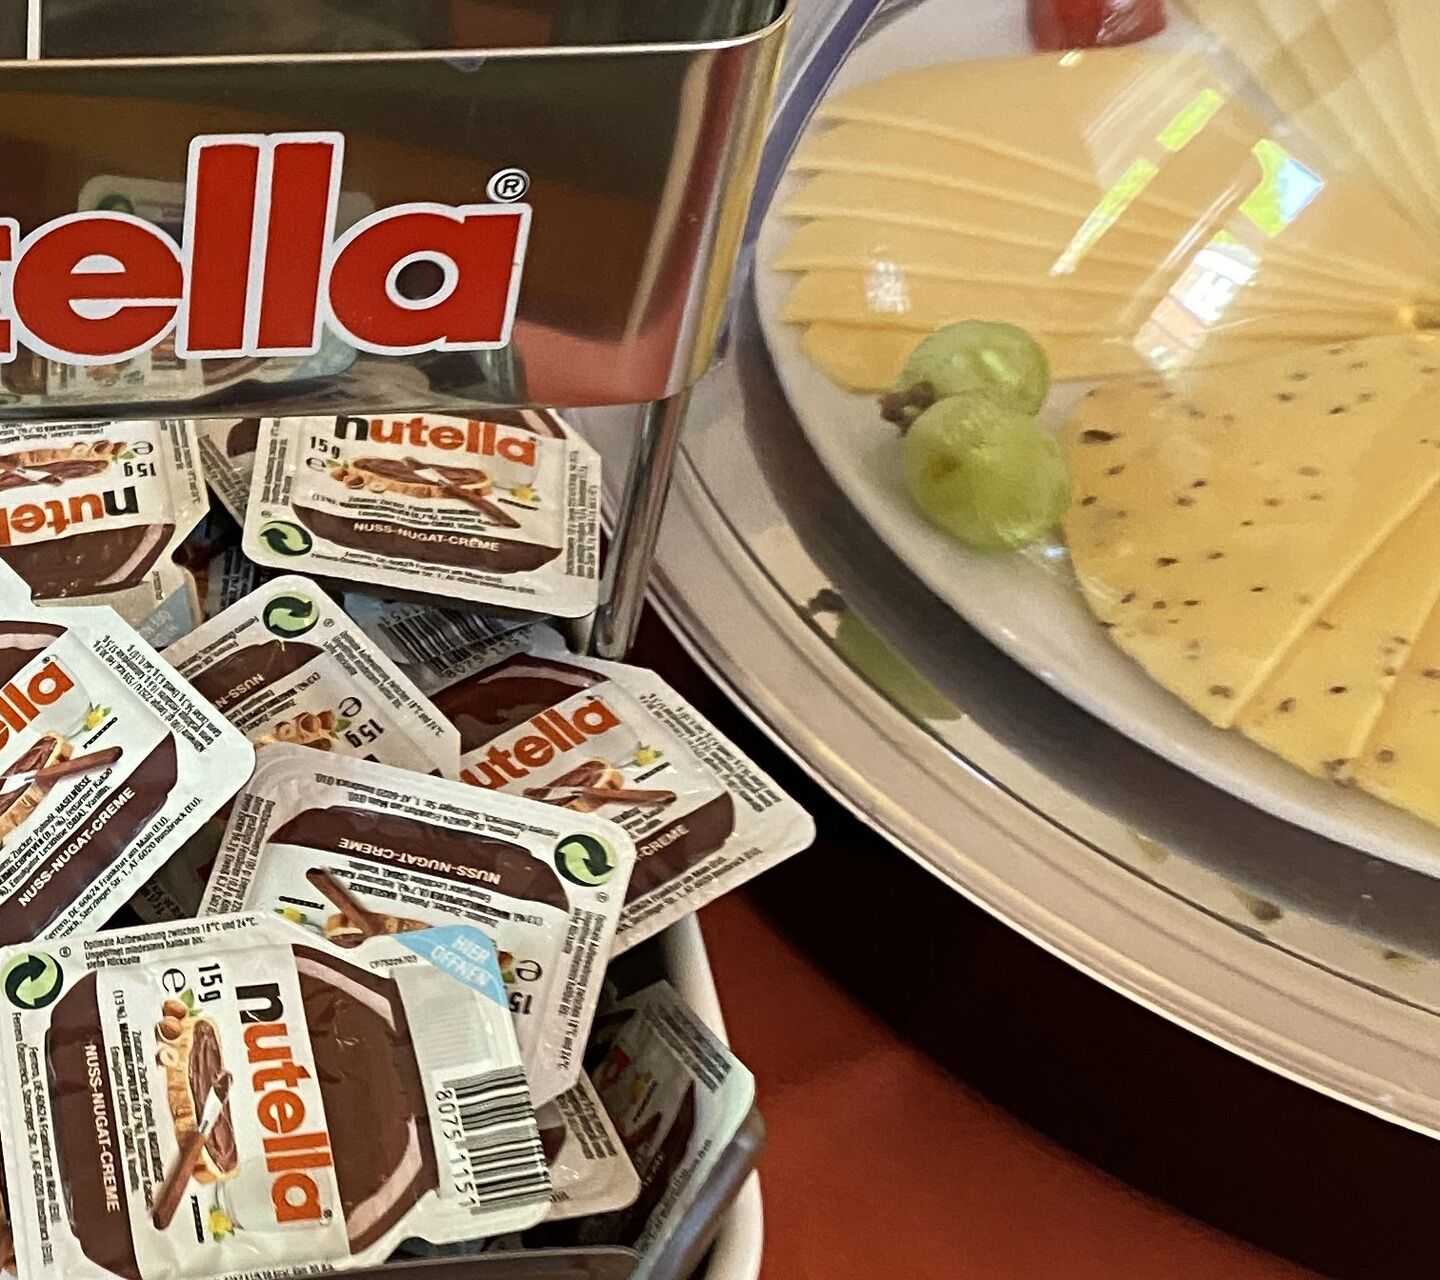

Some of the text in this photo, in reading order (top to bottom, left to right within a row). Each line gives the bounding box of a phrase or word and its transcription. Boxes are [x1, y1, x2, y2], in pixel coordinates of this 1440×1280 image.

[334, 414, 537, 467] nutella
[461, 698, 621, 790] utella
[18, 787, 136, 908] NUSS-NUGAT-CREME
[337, 837, 503, 886] NUSS-NUGAT-CREME
[84, 1044, 120, 1214] NUSS-NUGAT-CREME
[235, 982, 334, 1225] nutella
[436, 1089, 462, 1140] 8075
